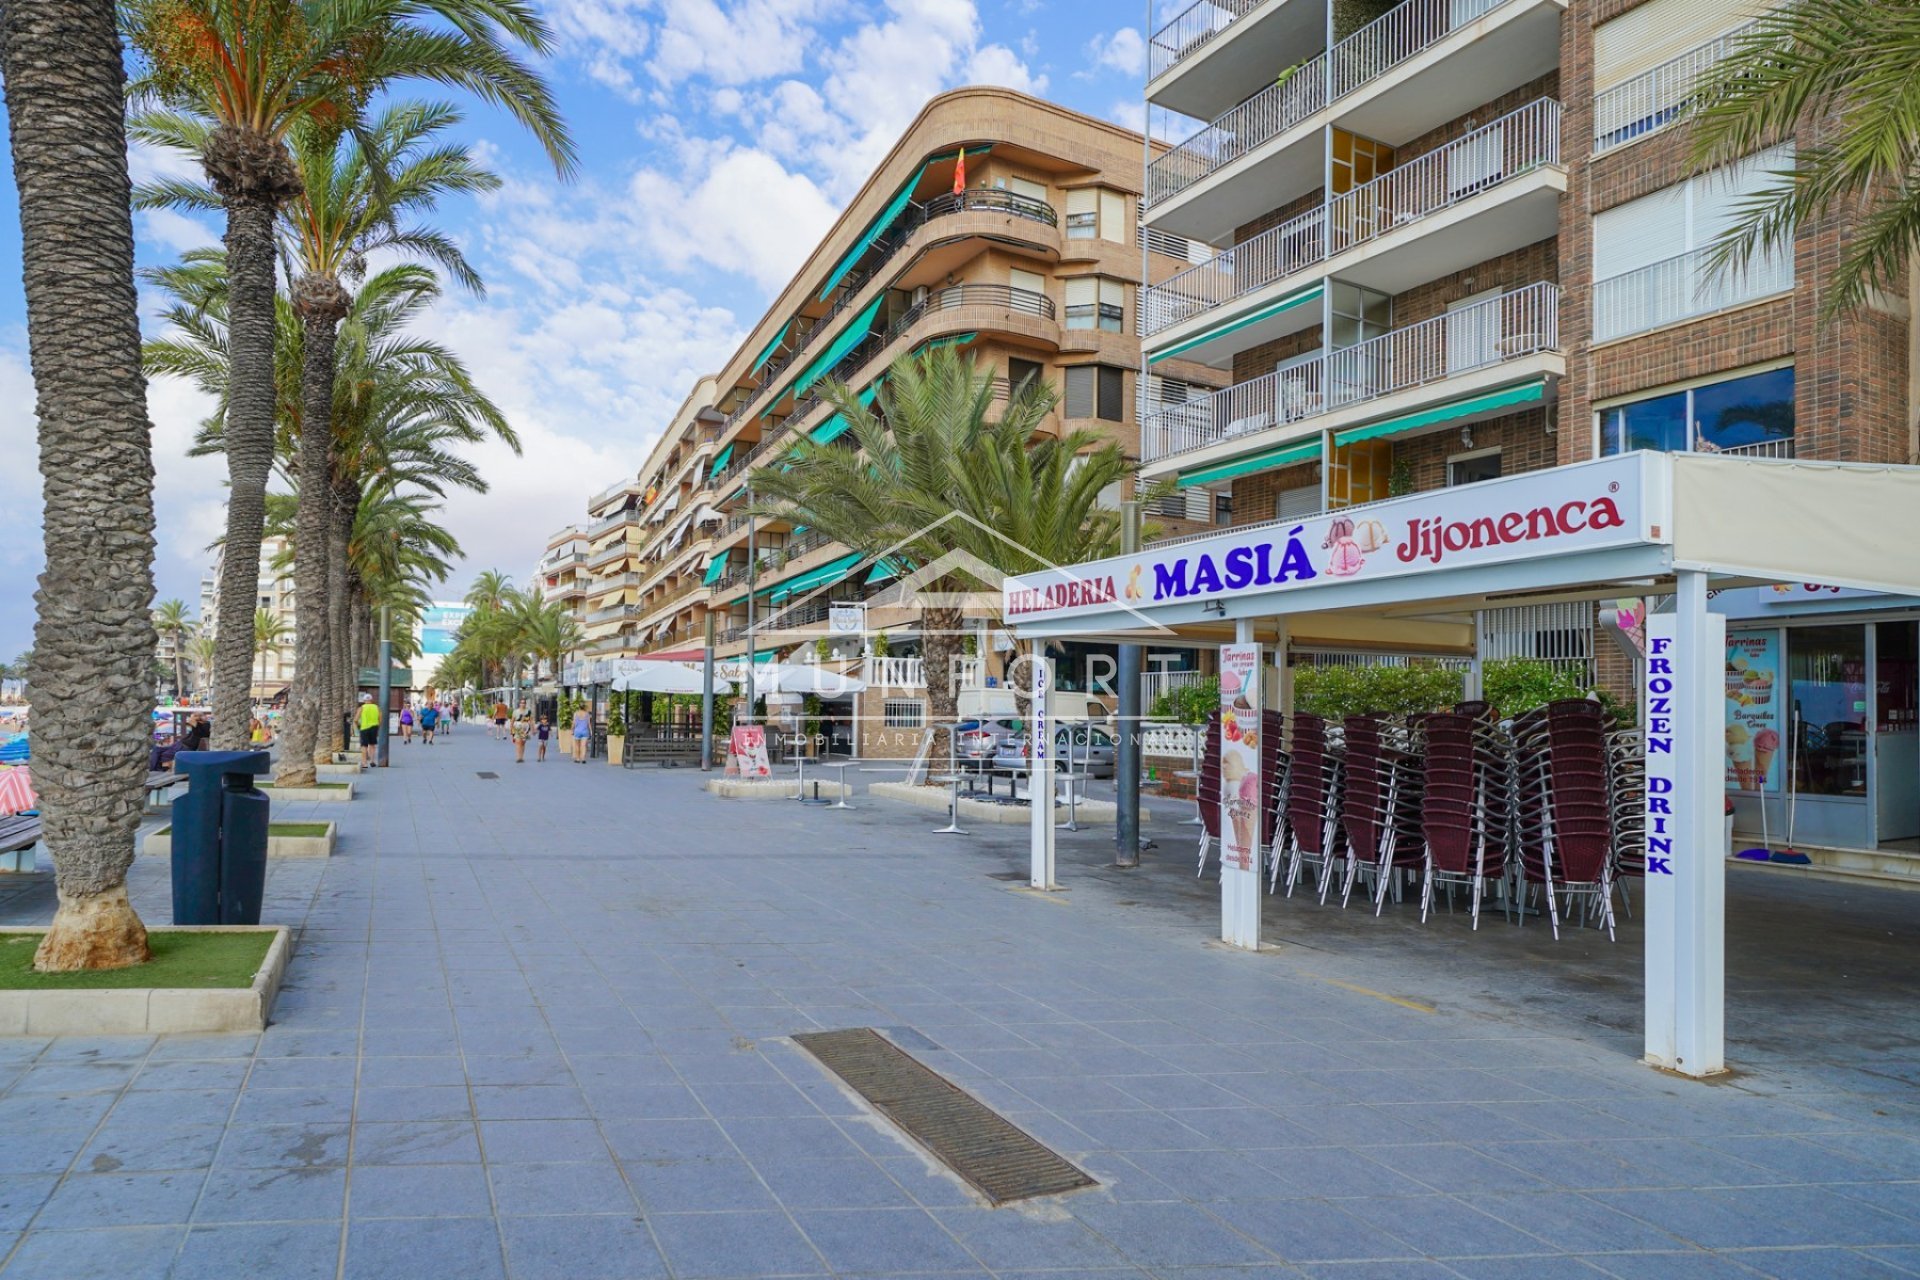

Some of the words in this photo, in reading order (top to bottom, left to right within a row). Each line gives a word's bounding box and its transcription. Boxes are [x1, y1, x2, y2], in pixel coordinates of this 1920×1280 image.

[1008, 576, 1118, 615] HELADERIA
[1153, 525, 1317, 600] MASIÁ
[1397, 497, 1625, 563] Jijonenca
[1037, 669, 1045, 699] ICE
[1222, 647, 1255, 663] Tarrinas
[1648, 638, 1673, 754] FROZEN
[1037, 710, 1045, 760] CREAM
[1648, 776, 1673, 875] DRINK
